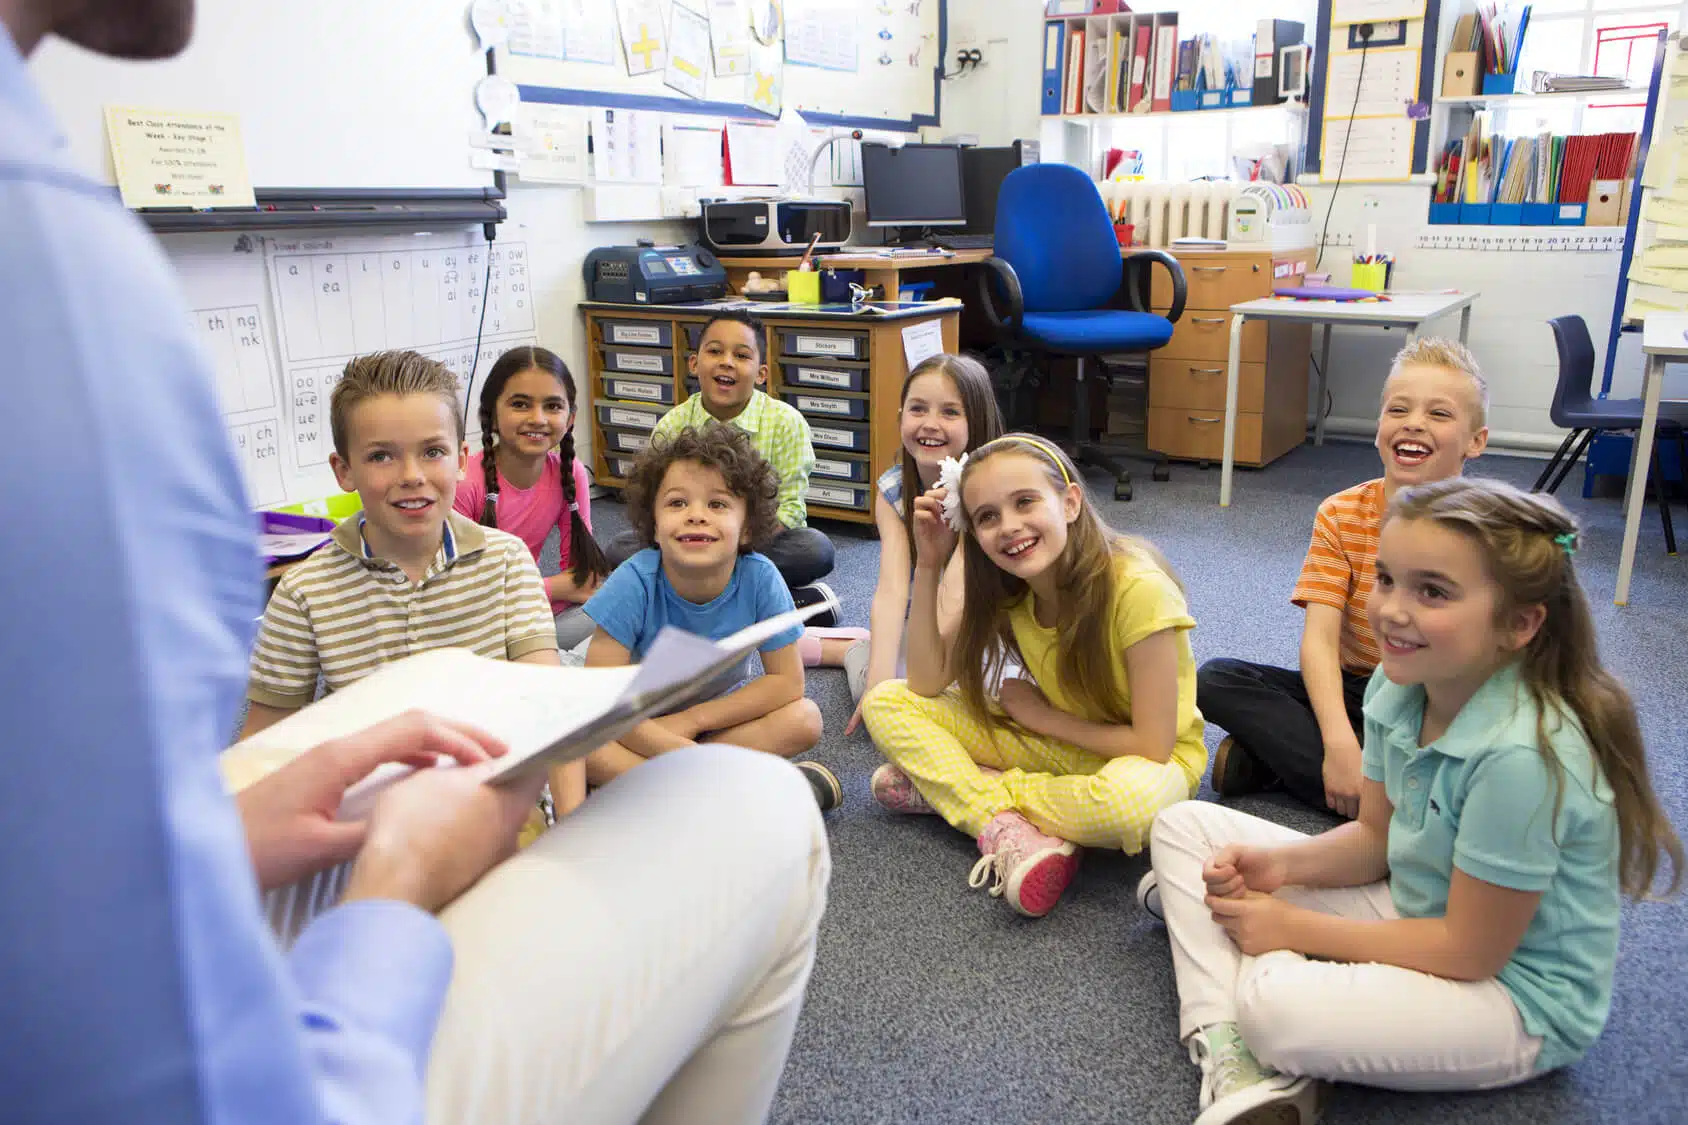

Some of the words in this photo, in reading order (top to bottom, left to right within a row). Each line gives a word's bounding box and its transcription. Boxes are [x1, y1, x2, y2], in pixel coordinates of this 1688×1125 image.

[127, 118, 143, 127] Best
[146, 120, 164, 128] Class
[167, 121, 203, 130] Attendance
[173, 133, 186, 142] Key
[188, 135, 207, 143] Stage
[288, 264, 298, 276] a
[325, 263, 335, 274] e
[392, 260, 401, 270] o
[422, 259, 430, 269] u
[508, 250, 524, 260] ow
[322, 282, 341, 293] ea
[511, 284, 525, 293] oa
[208, 315, 225, 332] th
[237, 315, 257, 331] ng
[241, 332, 261, 346] nk
[809, 372, 819, 380] Mrs
[296, 376, 314, 389] oo
[295, 392, 318, 407] u-e
[820, 402, 838, 410] Smyth
[298, 412, 316, 425] ue
[256, 424, 273, 440] ch
[298, 431, 318, 443] ew
[813, 432, 823, 440] Mrs
[256, 442, 276, 460] tch
[822, 489, 831, 497] Art
